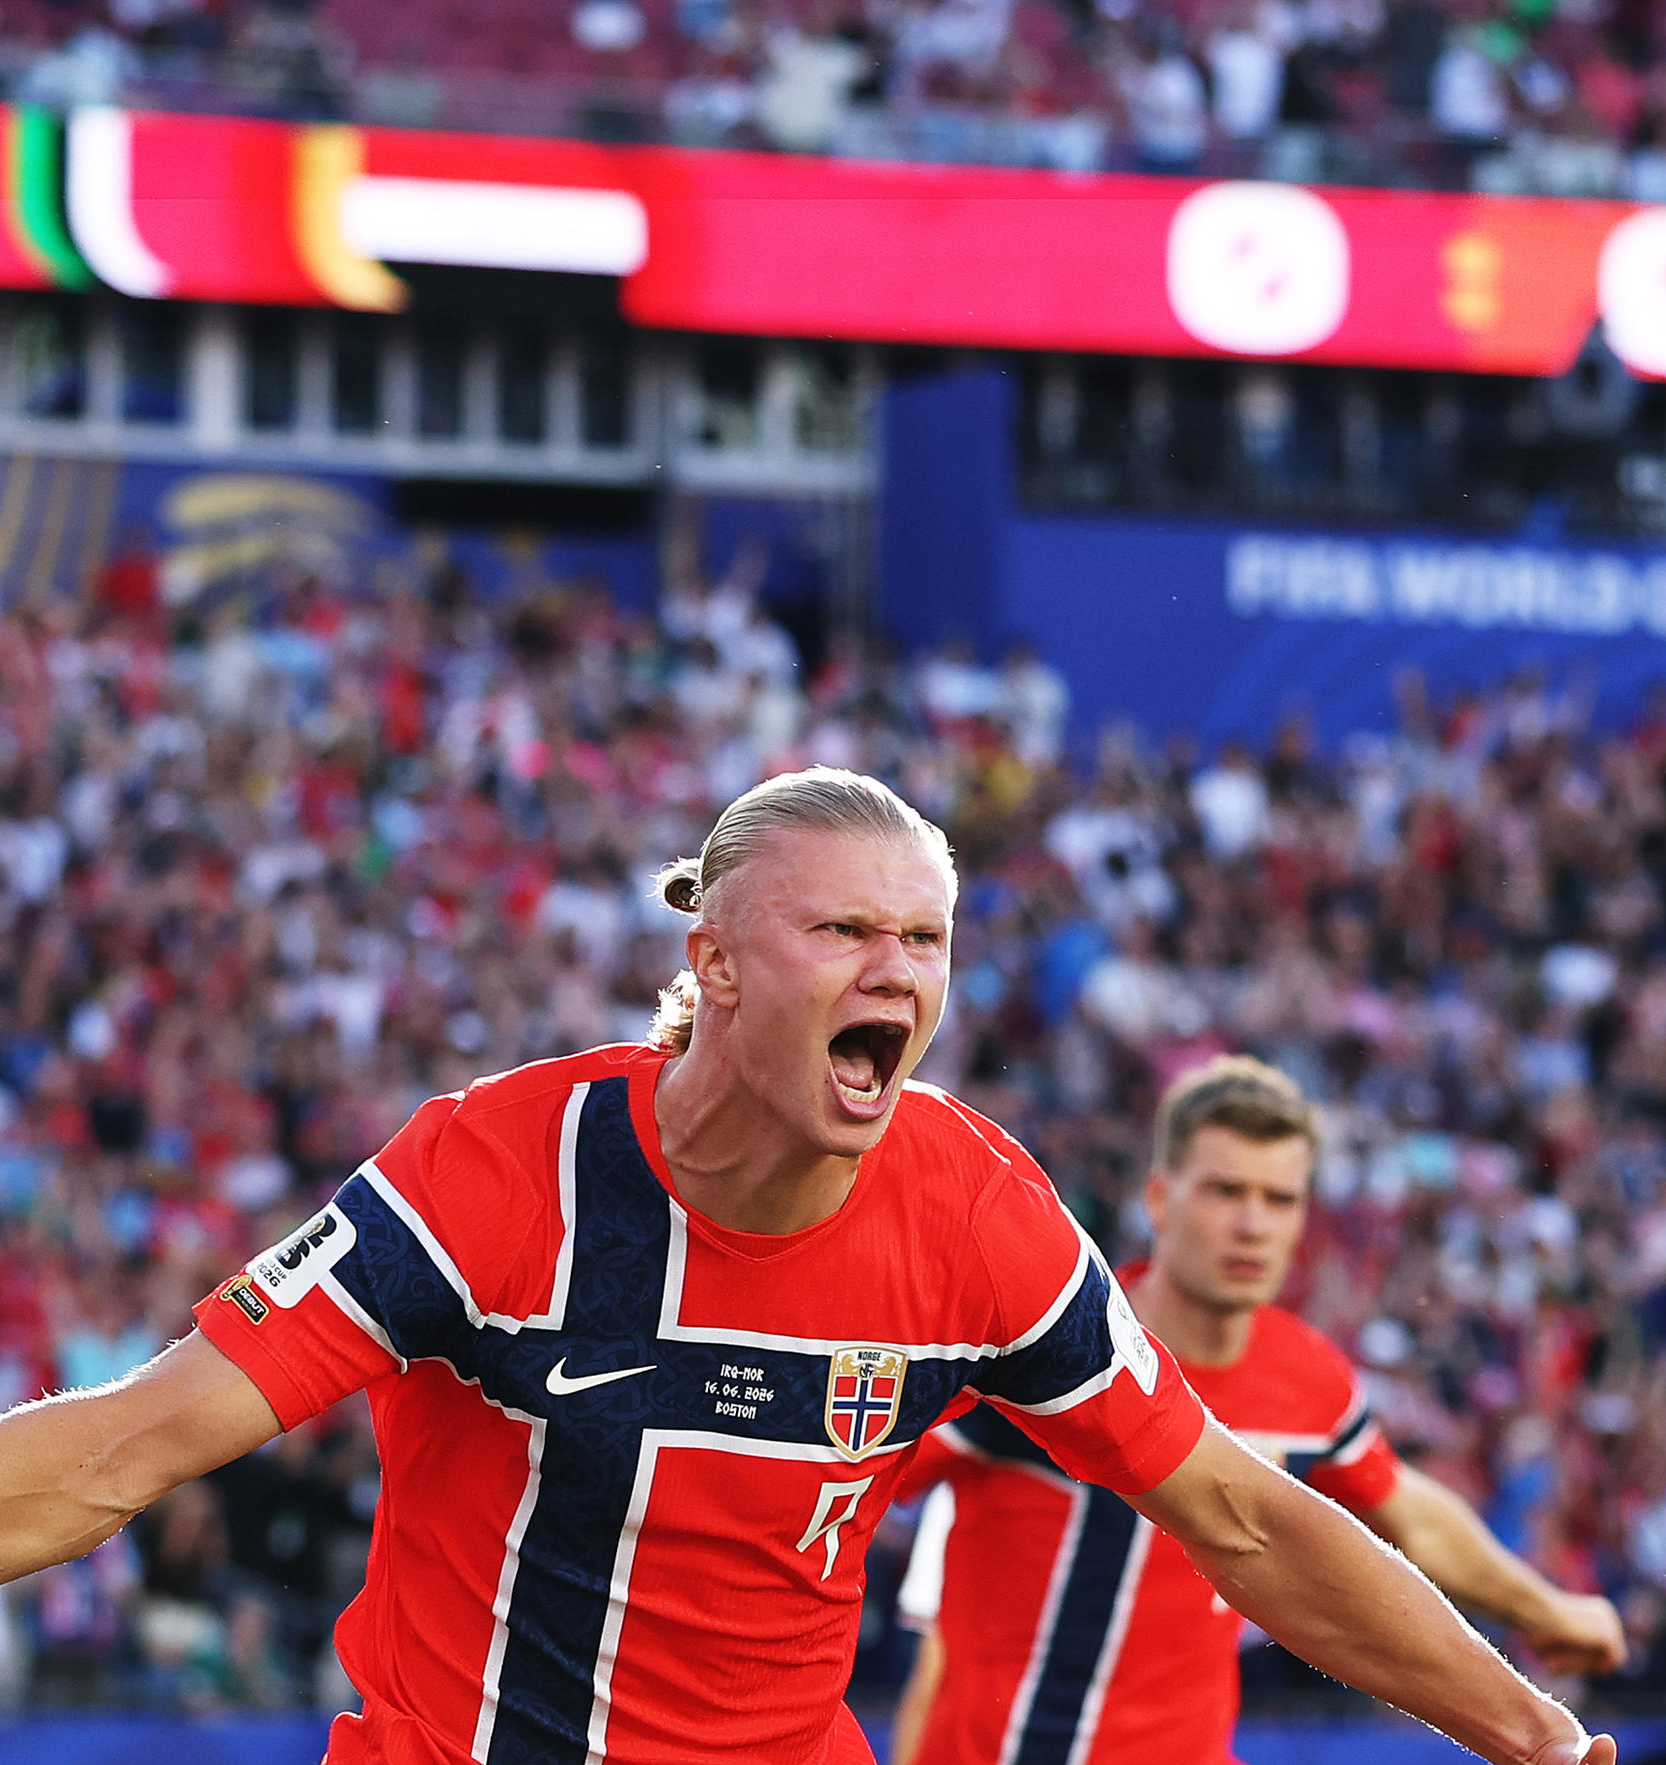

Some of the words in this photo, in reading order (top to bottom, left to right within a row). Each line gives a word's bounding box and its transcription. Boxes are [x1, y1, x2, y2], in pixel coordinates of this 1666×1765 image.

[1227, 535, 1376, 621] FIFA
[1391, 543, 1634, 634] WORLD
[238, 1288, 265, 1315] DEBUT
[857, 1351, 882, 1361] NORGE
[720, 1363, 765, 1382] IRQ-NOR
[715, 1400, 757, 1420] BOSTON
